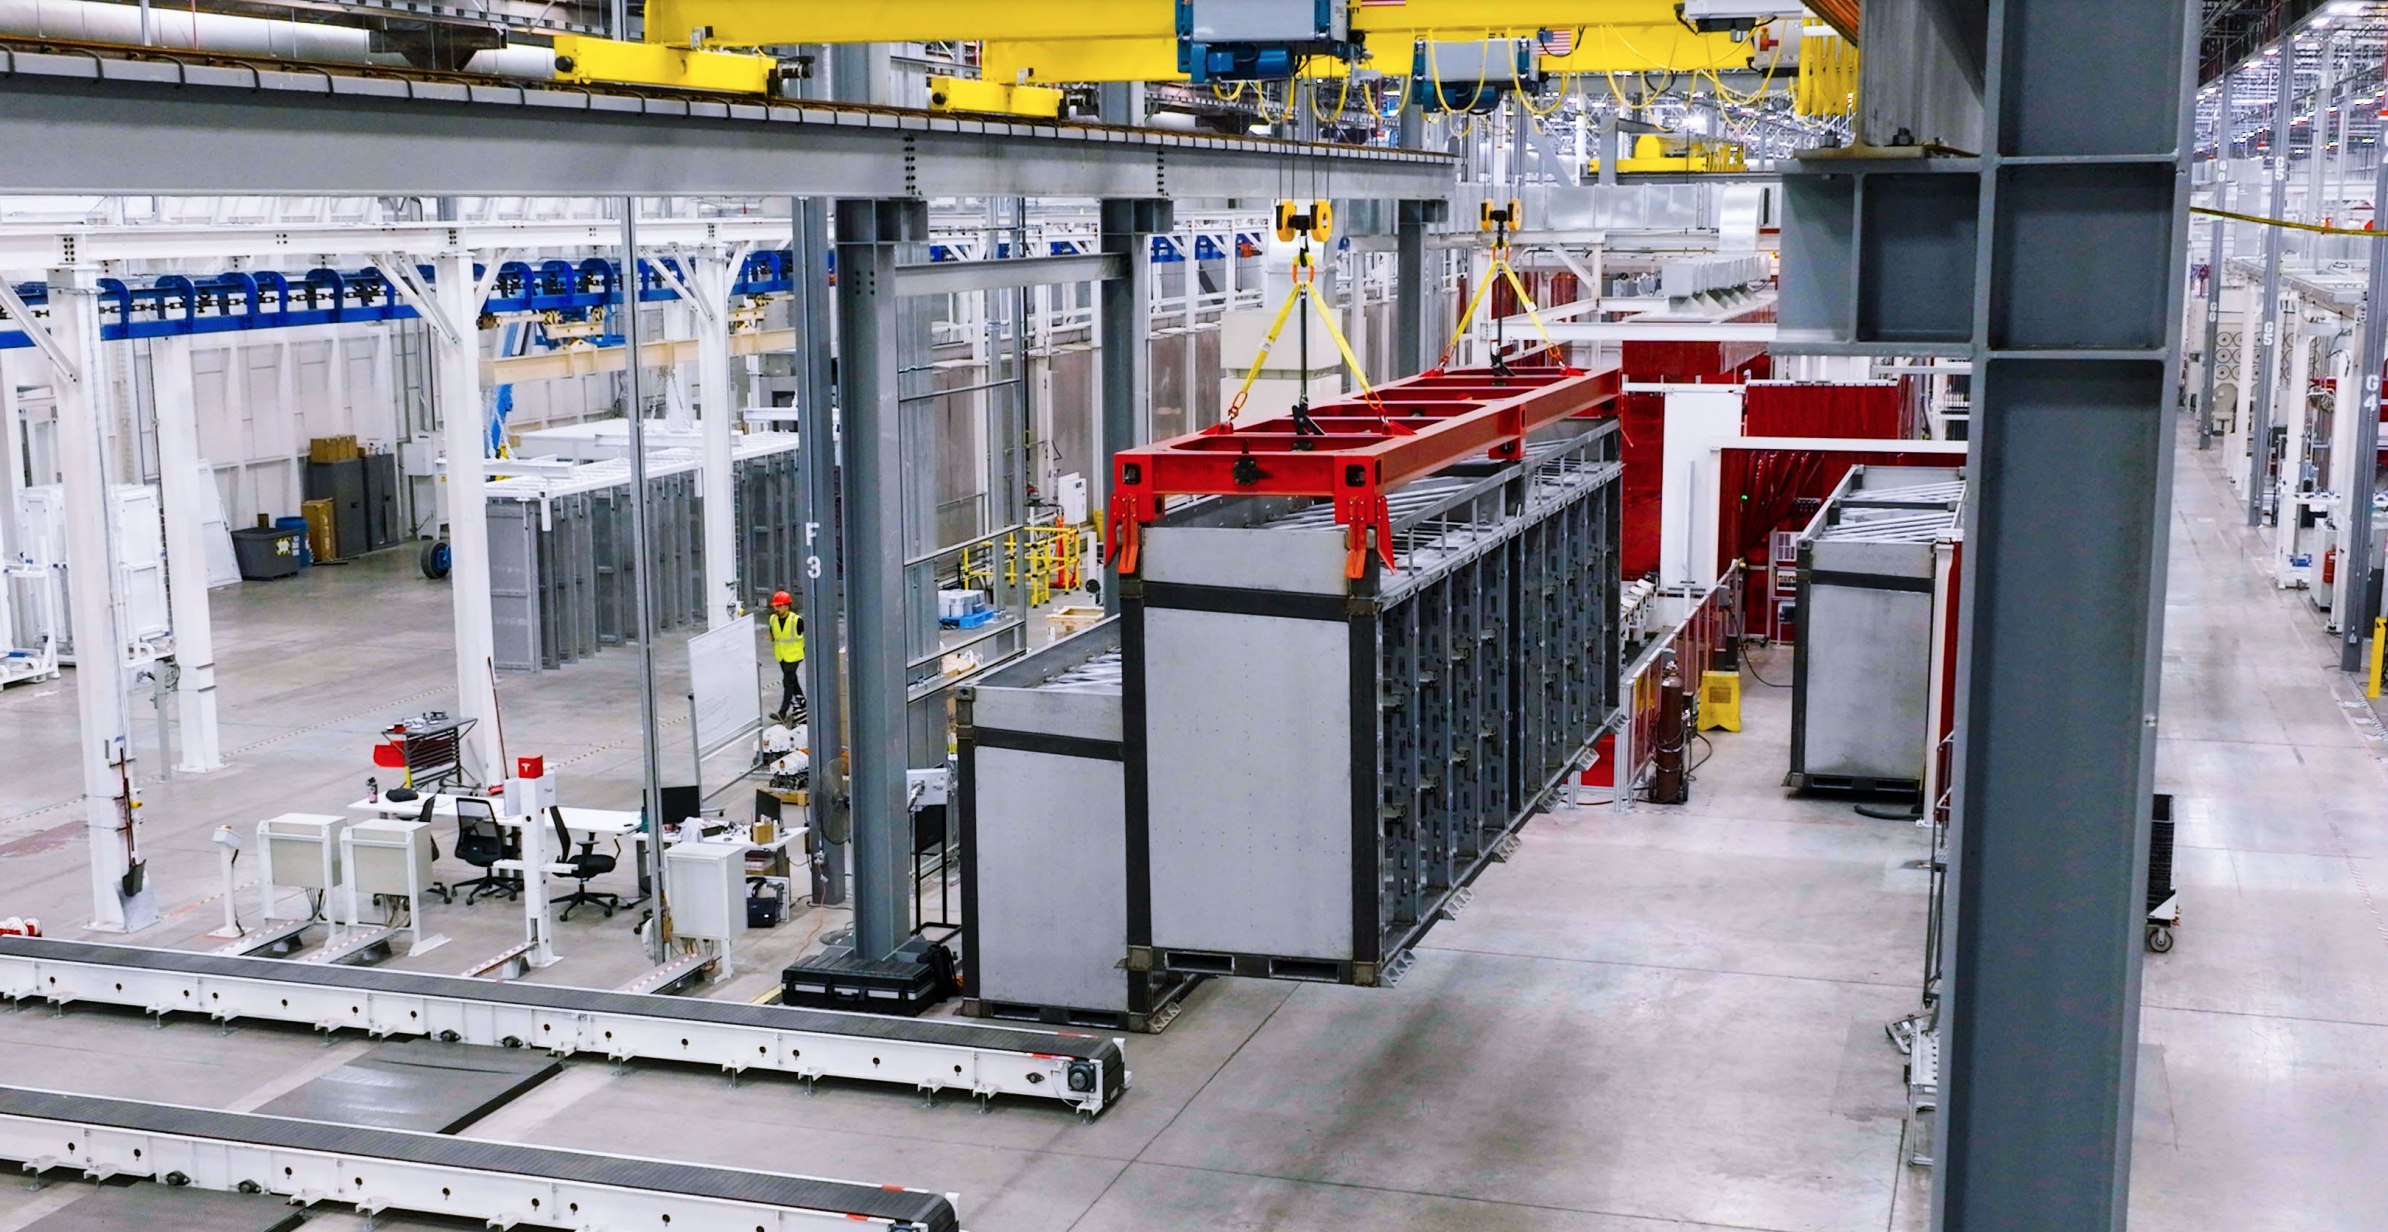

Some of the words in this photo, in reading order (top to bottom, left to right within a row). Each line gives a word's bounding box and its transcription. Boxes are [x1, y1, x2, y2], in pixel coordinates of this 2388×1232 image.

[2274, 156, 2285, 181] G5
[2263, 321, 2274, 346] G5
[2364, 374, 2380, 412] G4
